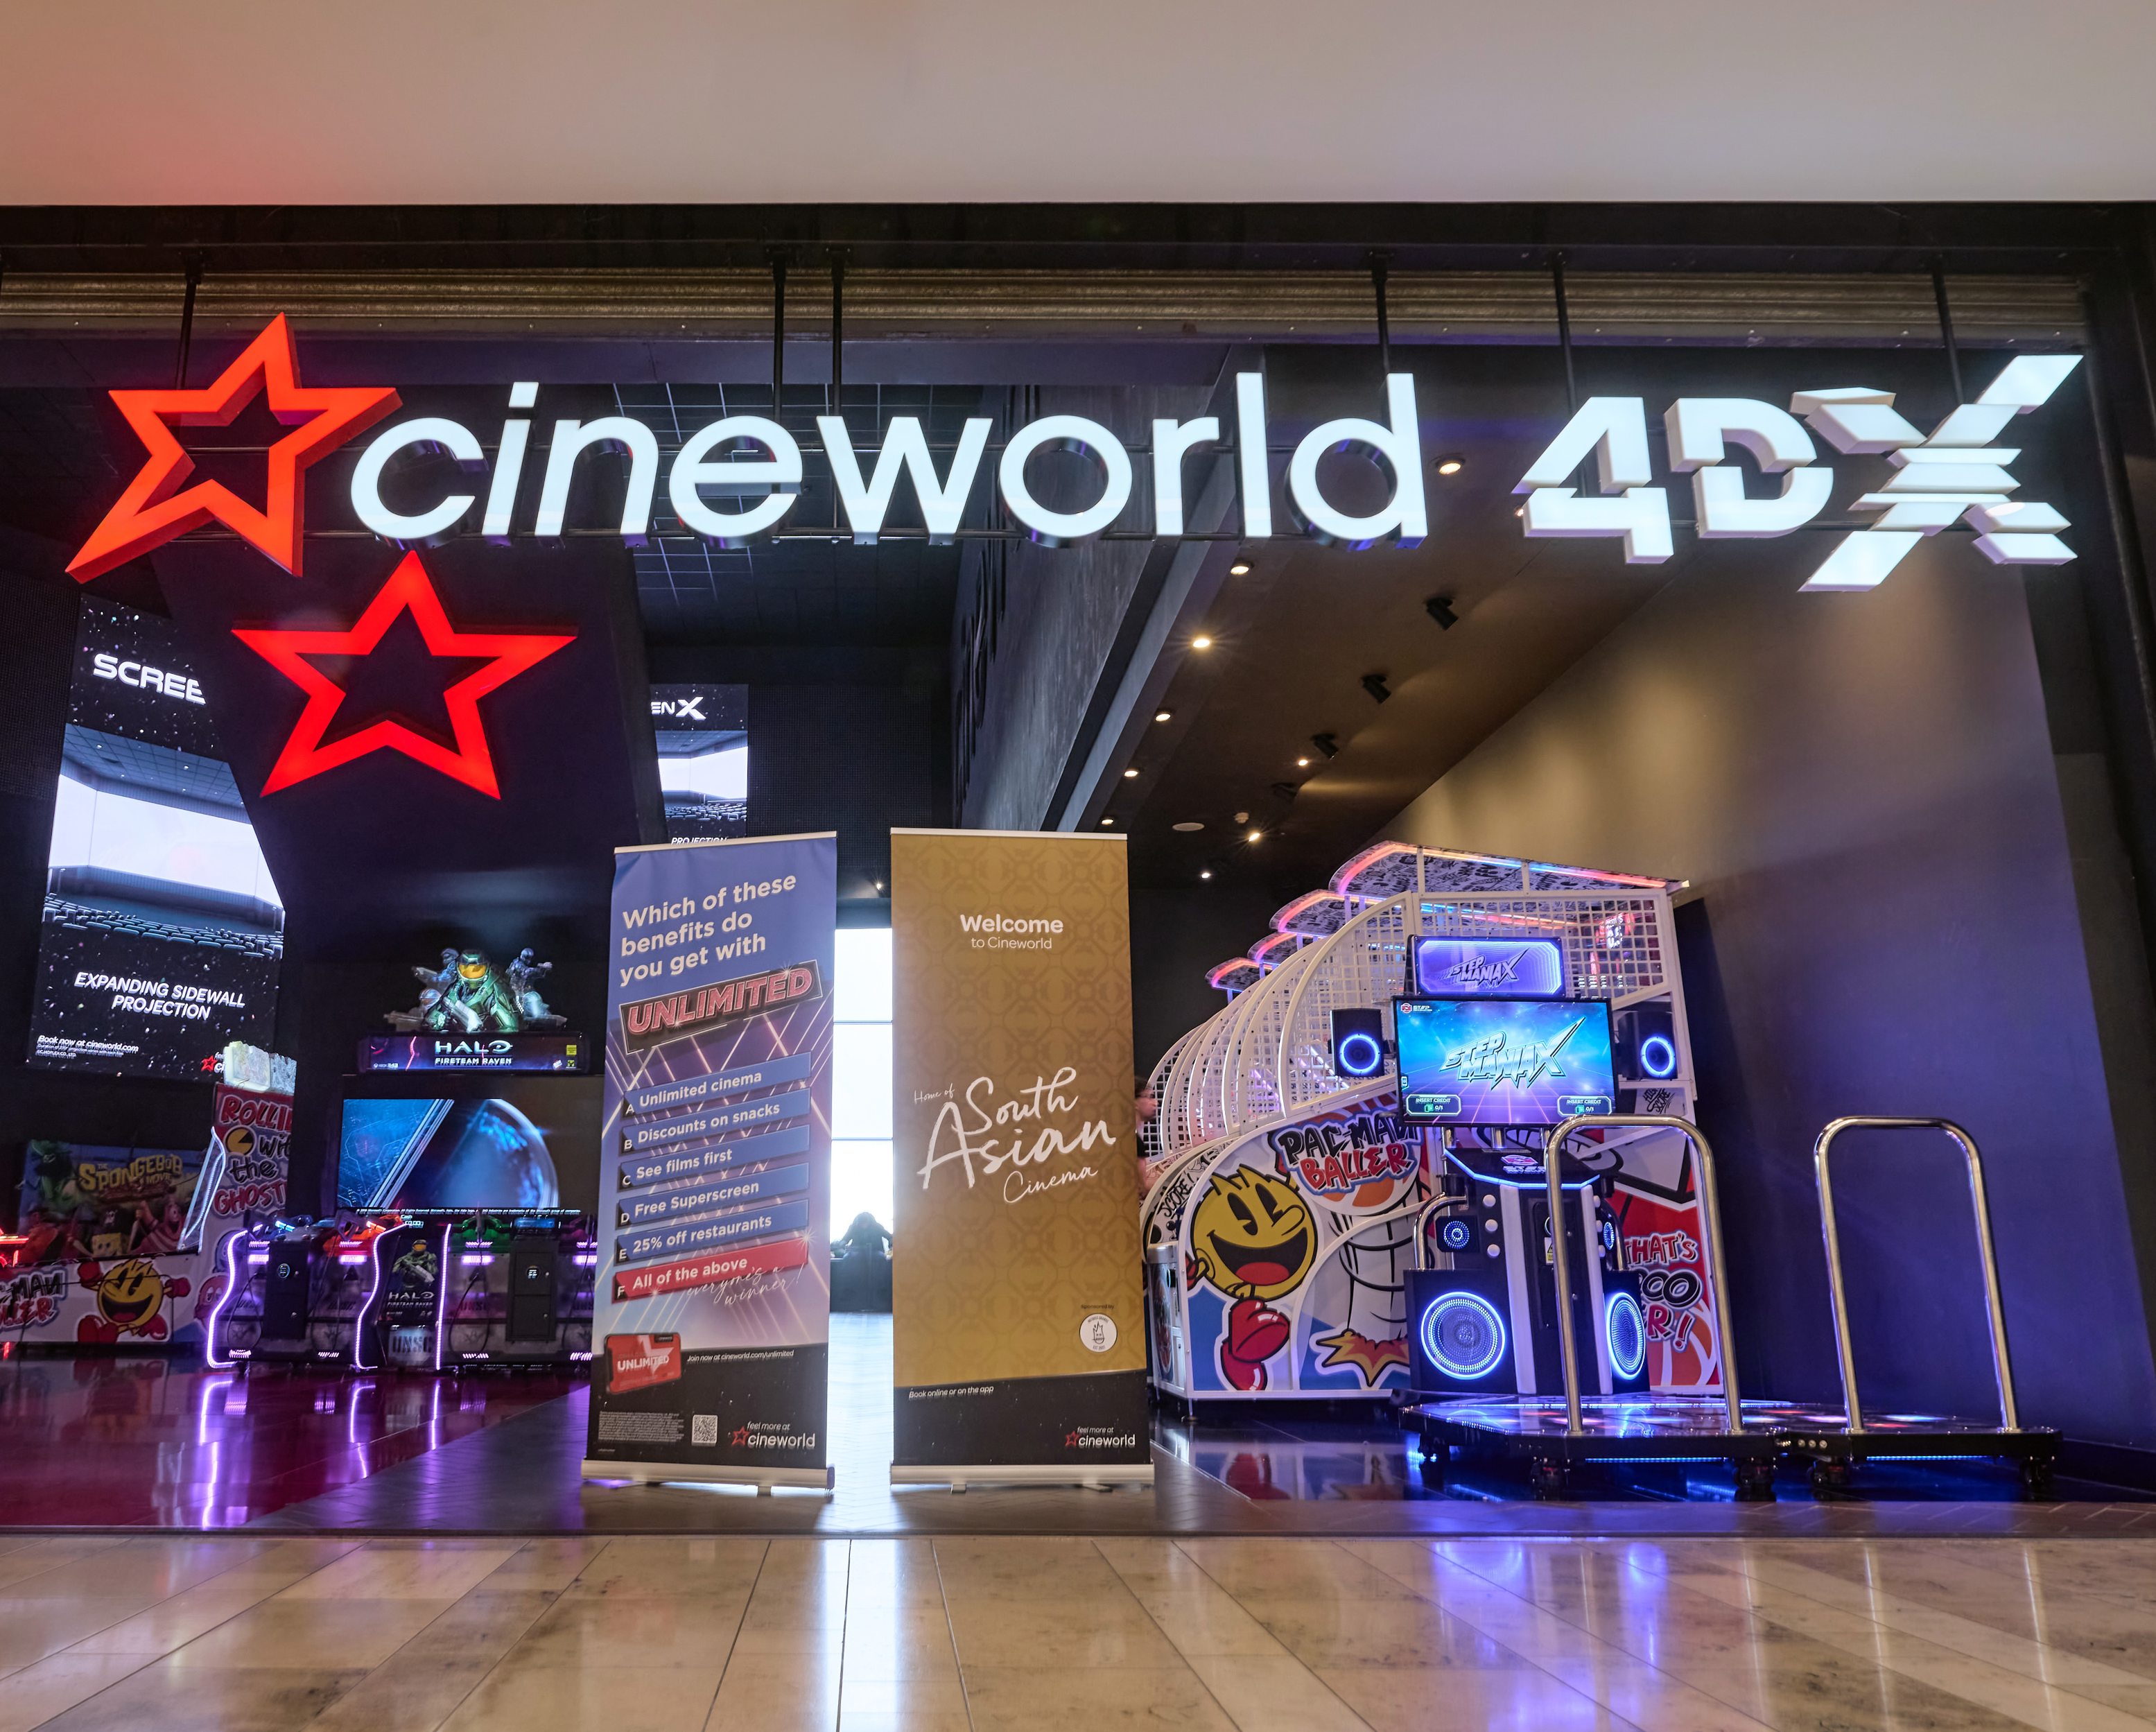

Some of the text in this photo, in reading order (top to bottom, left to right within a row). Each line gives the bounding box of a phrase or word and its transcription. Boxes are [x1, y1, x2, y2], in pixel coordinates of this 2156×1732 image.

[350, 354, 2084, 592] cineworld 4DX
[623, 874, 797, 929] Which of these
[620, 911, 753, 958] benefits do
[959, 913, 1064, 933] Welcome
[971, 937, 1053, 949] to Cineworld
[620, 933, 766, 987] you get with
[1450, 955, 1486, 976] STEP
[1460, 947, 1530, 987] MANIAX
[74, 971, 245, 1008] EXPANDING SIDEWALL
[627, 968, 813, 1035] UNLIMITED
[112, 995, 211, 1021] PROJECTION
[37, 1035, 58, 1044] Book
[85, 1040, 139, 1053] cineworld.com
[435, 1040, 513, 1055] HALO
[1439, 1030, 1506, 1072] STEP
[1457, 1016, 1586, 1090] MANIAX
[435, 1057, 512, 1066] FIRETEAM RAVEN
[639, 1071, 763, 1107] Unlimited cinema
[914, 1082, 955, 1105] Home of
[951, 1066, 1080, 1136] South
[625, 1104, 635, 1116] A
[637, 1102, 781, 1144] Discounts on snacks
[624, 1139, 633, 1150] B
[916, 1100, 1117, 1190] Asian
[1278, 1111, 1421, 1166] PAC-MAN
[79, 1154, 183, 1191] SPONGEBOB
[229, 1156, 277, 1183] the
[623, 1175, 632, 1186] C
[636, 1148, 733, 1181] See films first
[1299, 1143, 1412, 1190] BALLER
[214, 1180, 287, 1215] GHOST
[634, 1180, 760, 1217] Free Superscreen
[1003, 1166, 1099, 1204] Cinema
[620, 1213, 630, 1224] D
[632, 1214, 772, 1254] 25% off restaurants
[618, 1248, 627, 1260] E
[632, 1256, 749, 1290] All of the above
[687, 1266, 767, 1304] everyone's
[388, 1291, 435, 1299] HALO
[617, 1285, 625, 1298] F
[617, 1356, 670, 1371] UNLIMITED
[721, 1349, 794, 1360] cineworld.com/unlimited
[908, 1390, 928, 1398] Book
[747, 1421, 761, 1430] feel
[747, 1432, 816, 1447] cineworld
[1078, 1433, 1136, 1447] cineworld
